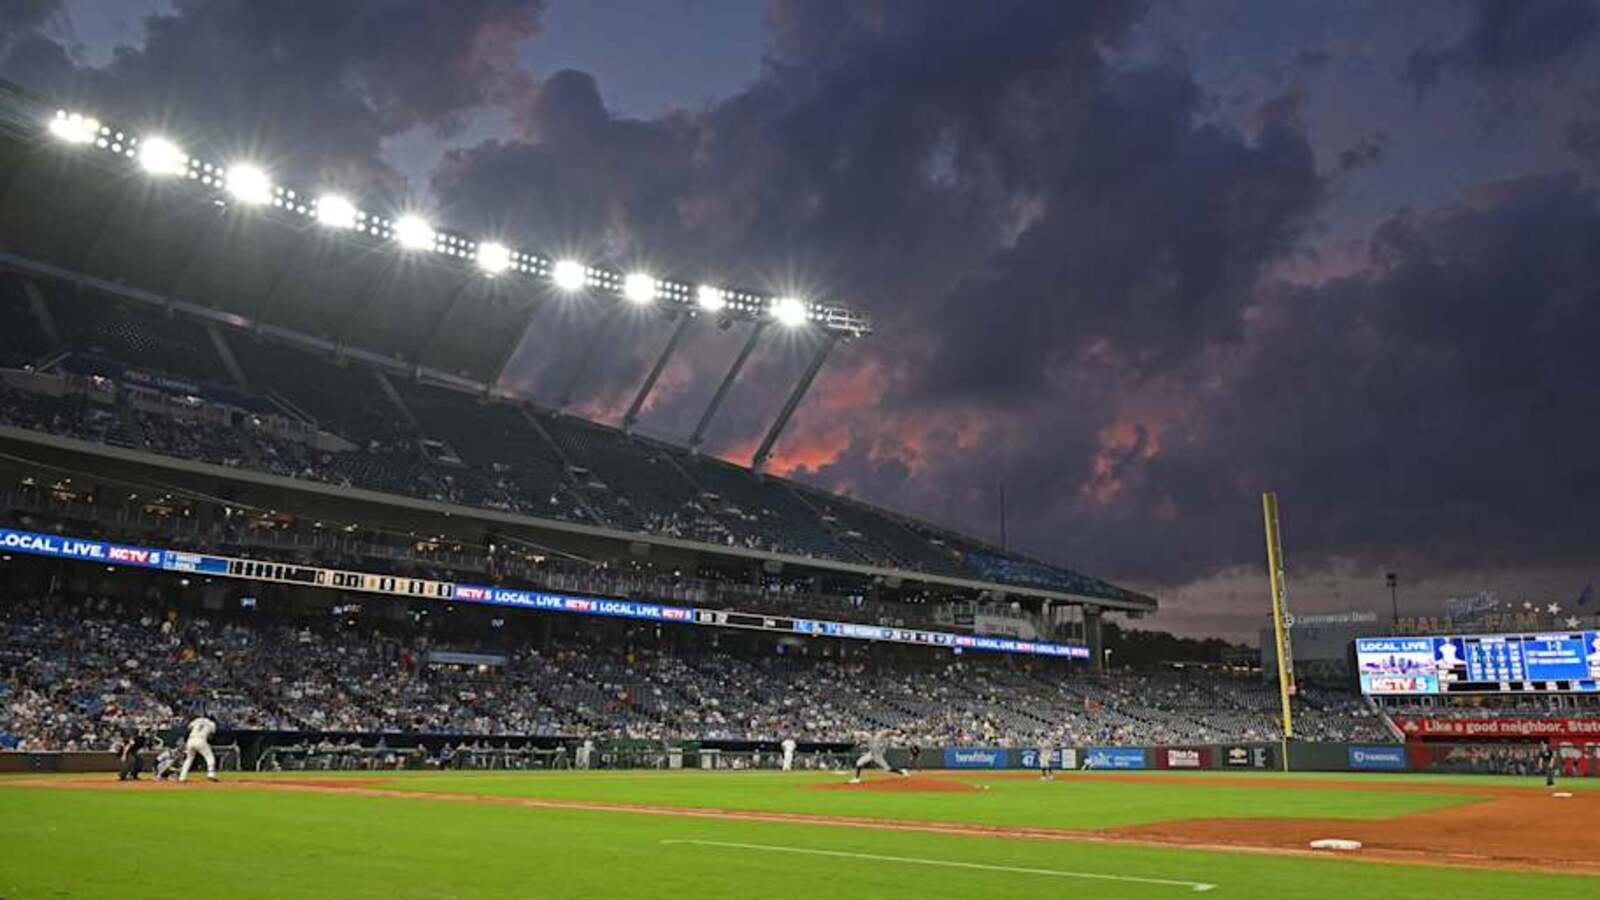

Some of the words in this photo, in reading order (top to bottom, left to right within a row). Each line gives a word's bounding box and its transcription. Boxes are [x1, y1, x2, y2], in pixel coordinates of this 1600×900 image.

[63, 541, 105, 557] LIVE.
[109, 547, 147, 562] KCTV
[149, 551, 160, 564] 5
[1424, 721, 1451, 732] Like
[1455, 723, 1463, 732] a
[1466, 720, 1498, 733] good
[1501, 721, 1565, 735] neighbor,
